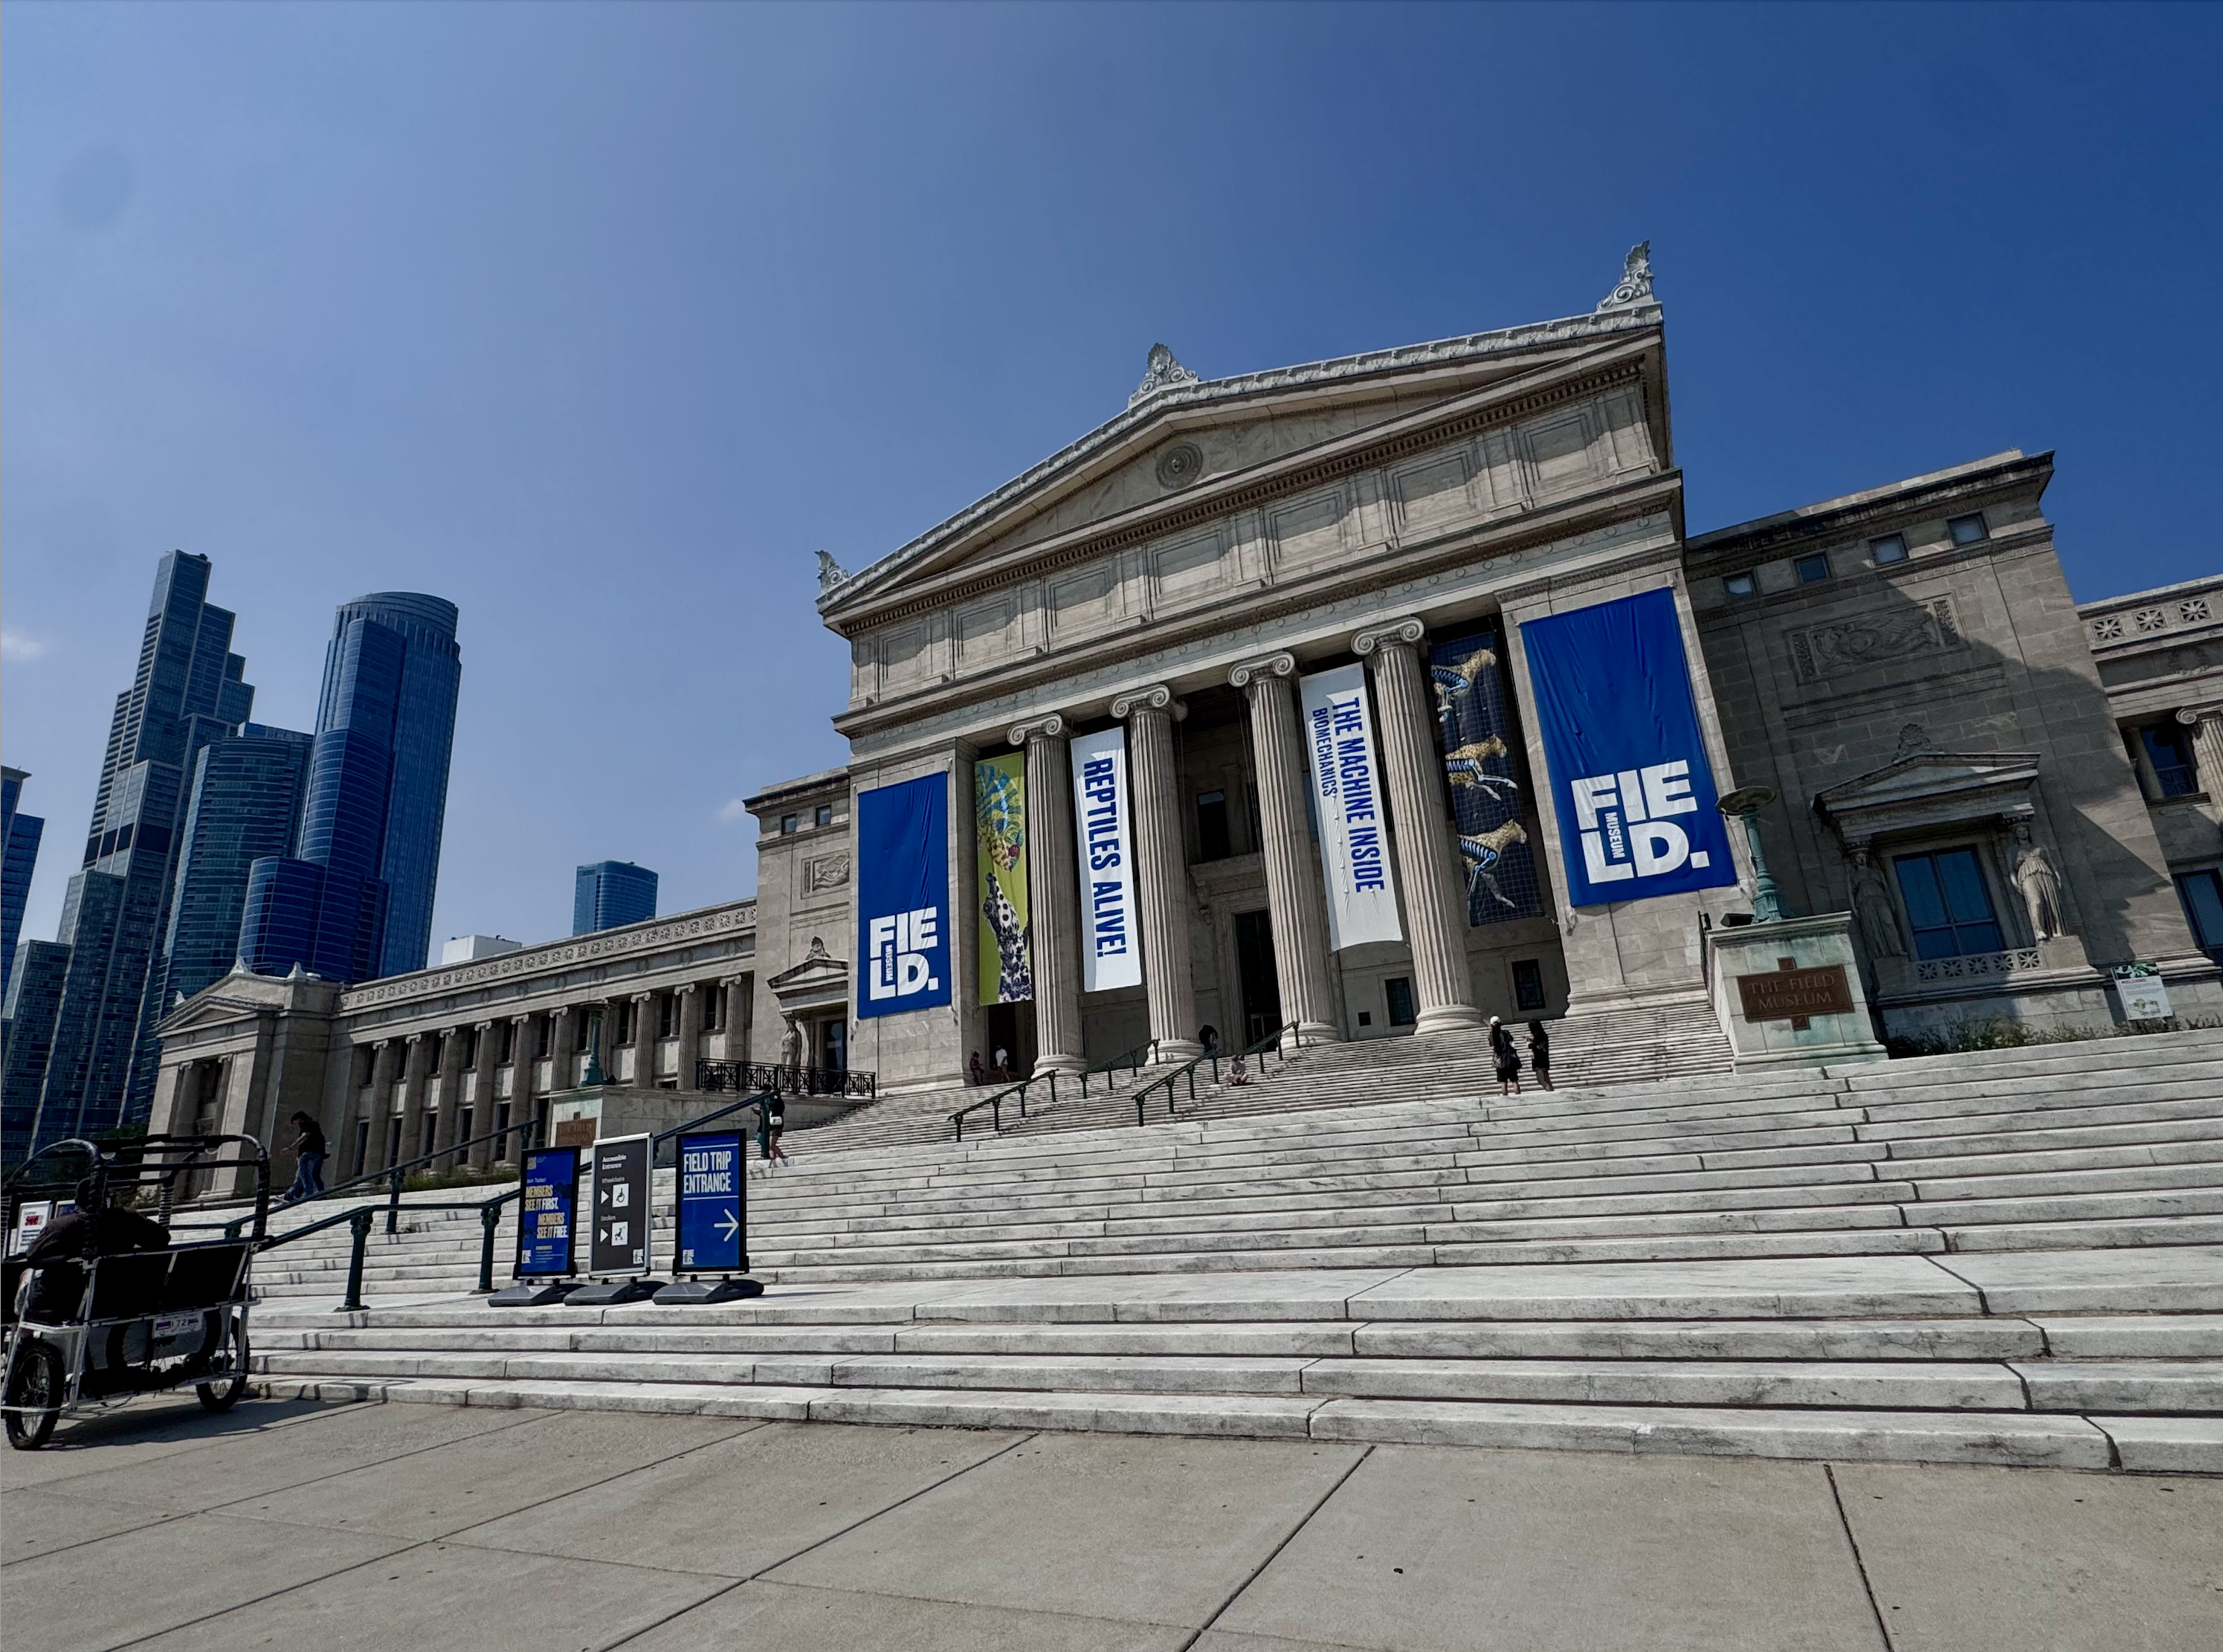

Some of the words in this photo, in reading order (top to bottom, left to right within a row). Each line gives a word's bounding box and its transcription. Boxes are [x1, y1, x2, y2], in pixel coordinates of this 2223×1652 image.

[1332, 697, 1362, 736] THE
[1312, 707, 1338, 797] BIOMECHANICS
[1338, 738, 1375, 824] MACHINE
[1084, 757, 1121, 871] REPTILES
[1604, 811, 1624, 859] MUSEUM
[1349, 826, 1384, 892] INSIDE
[1093, 880, 1126, 958] ALIVE!
[885, 943, 894, 981] MUSEUM
[1748, 980, 1783, 995] THE
[1790, 974, 1835, 990] FIELD
[1758, 991, 1832, 1010] MUSEUM
[602, 1154, 627, 1163] Accessible
[683, 1152, 709, 1172] FIELD
[710, 1150, 732, 1171] TRIP
[526, 1184, 553, 1198] MEMBERS
[683, 1172, 732, 1194] ENTRANCE
[525, 1198, 535, 1211] SEE
[535, 1198, 541, 1210] IT
[538, 1212, 565, 1226] MEMBERS
[537, 1226, 548, 1239] SEE
[547, 1226, 554, 1239] IT
